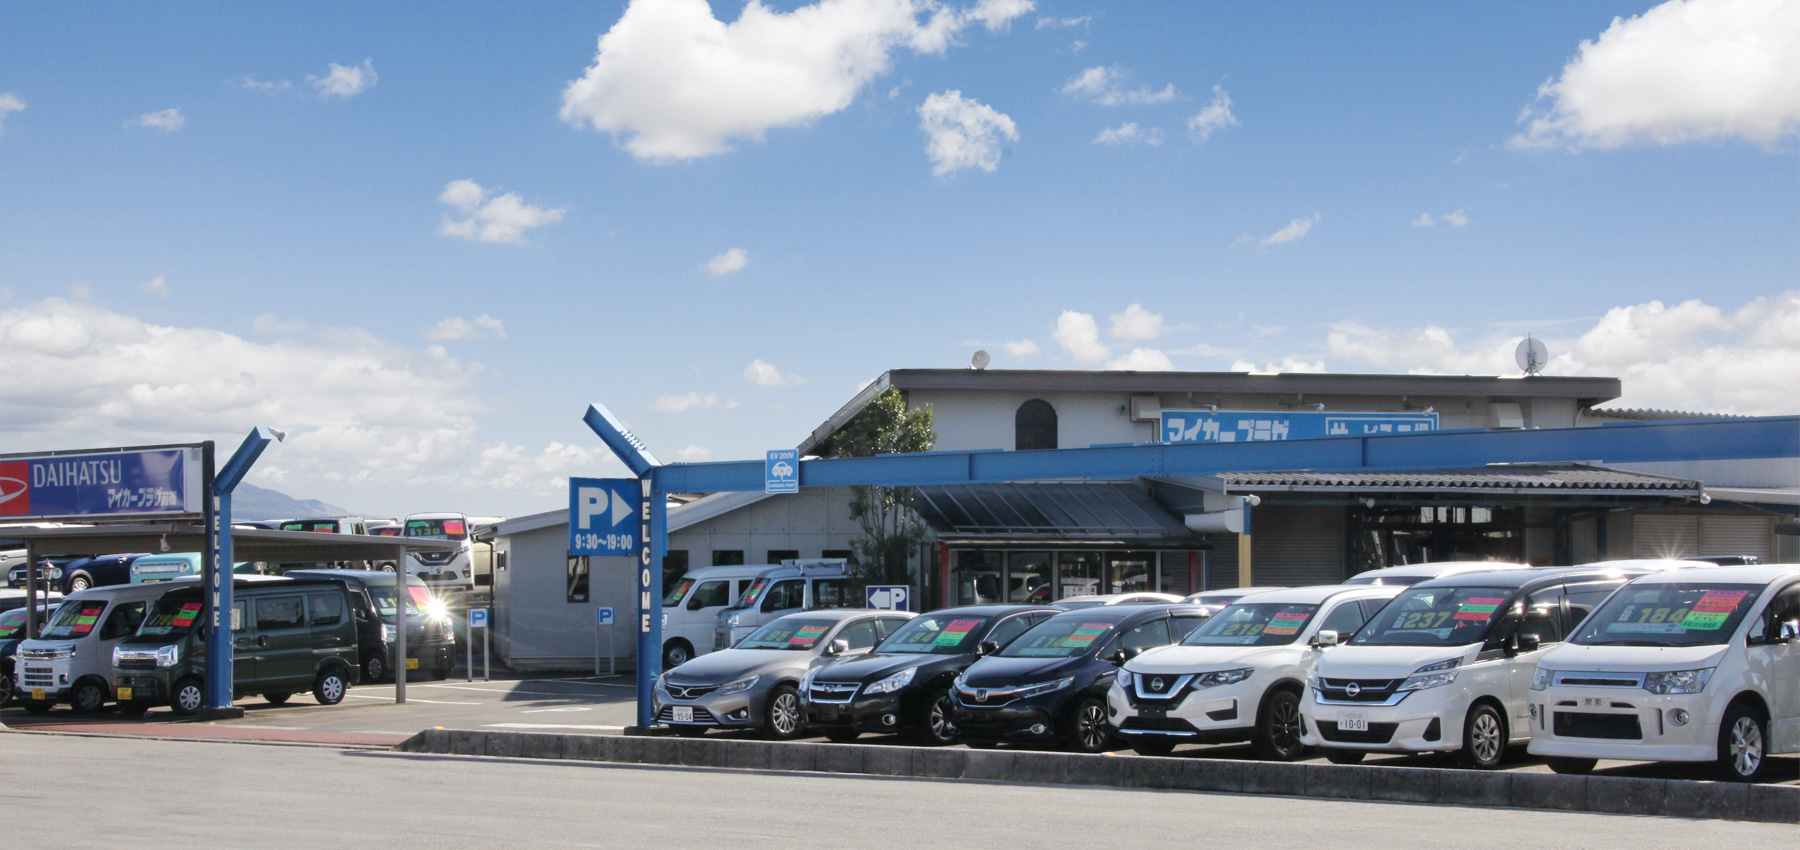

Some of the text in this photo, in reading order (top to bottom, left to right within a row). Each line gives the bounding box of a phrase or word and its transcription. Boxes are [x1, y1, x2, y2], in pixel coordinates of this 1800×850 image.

[770, 452, 795, 460] EV 200V
[33, 460, 121, 487] DAIHATSU
[578, 487, 609, 529] P
[641, 479, 651, 633] WELCOME
[890, 588, 906, 610] P
[471, 610, 486, 625] P
[600, 609, 612, 622] P
[1402, 611, 1451, 628] 237
[1638, 607, 1689, 623] 184
[1220, 623, 1266, 636] 219
